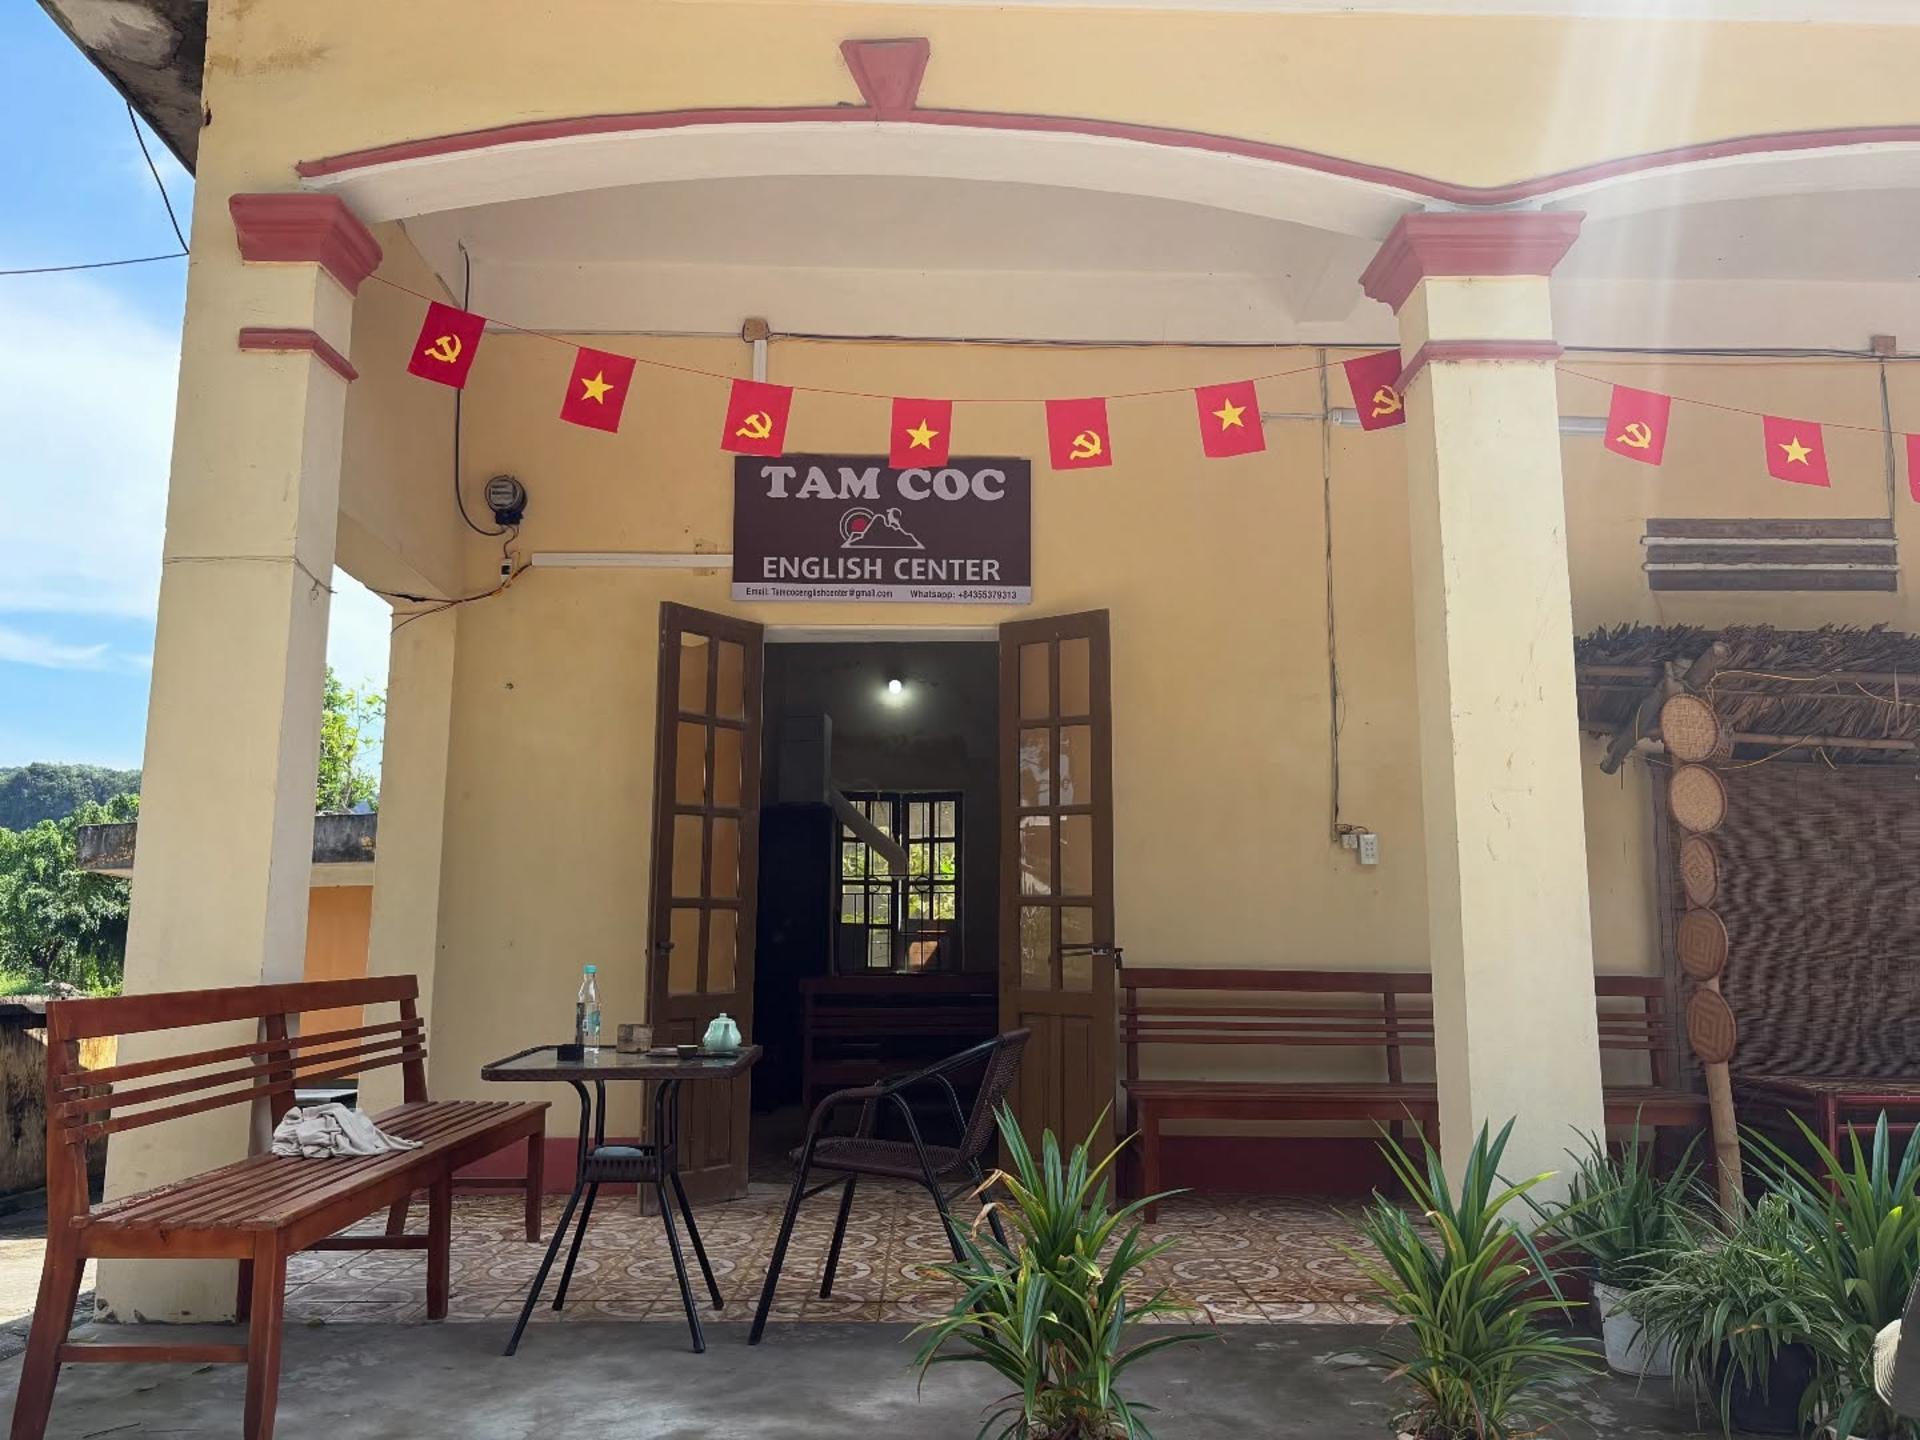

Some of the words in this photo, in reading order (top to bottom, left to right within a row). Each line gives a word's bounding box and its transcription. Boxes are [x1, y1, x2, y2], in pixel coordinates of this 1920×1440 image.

[760, 465, 881, 500] TAM
[896, 467, 1006, 501] COC
[763, 556, 882, 580] ENGLISH
[894, 557, 1001, 581] CENTER
[910, 589, 956, 600] Whatsapp:
